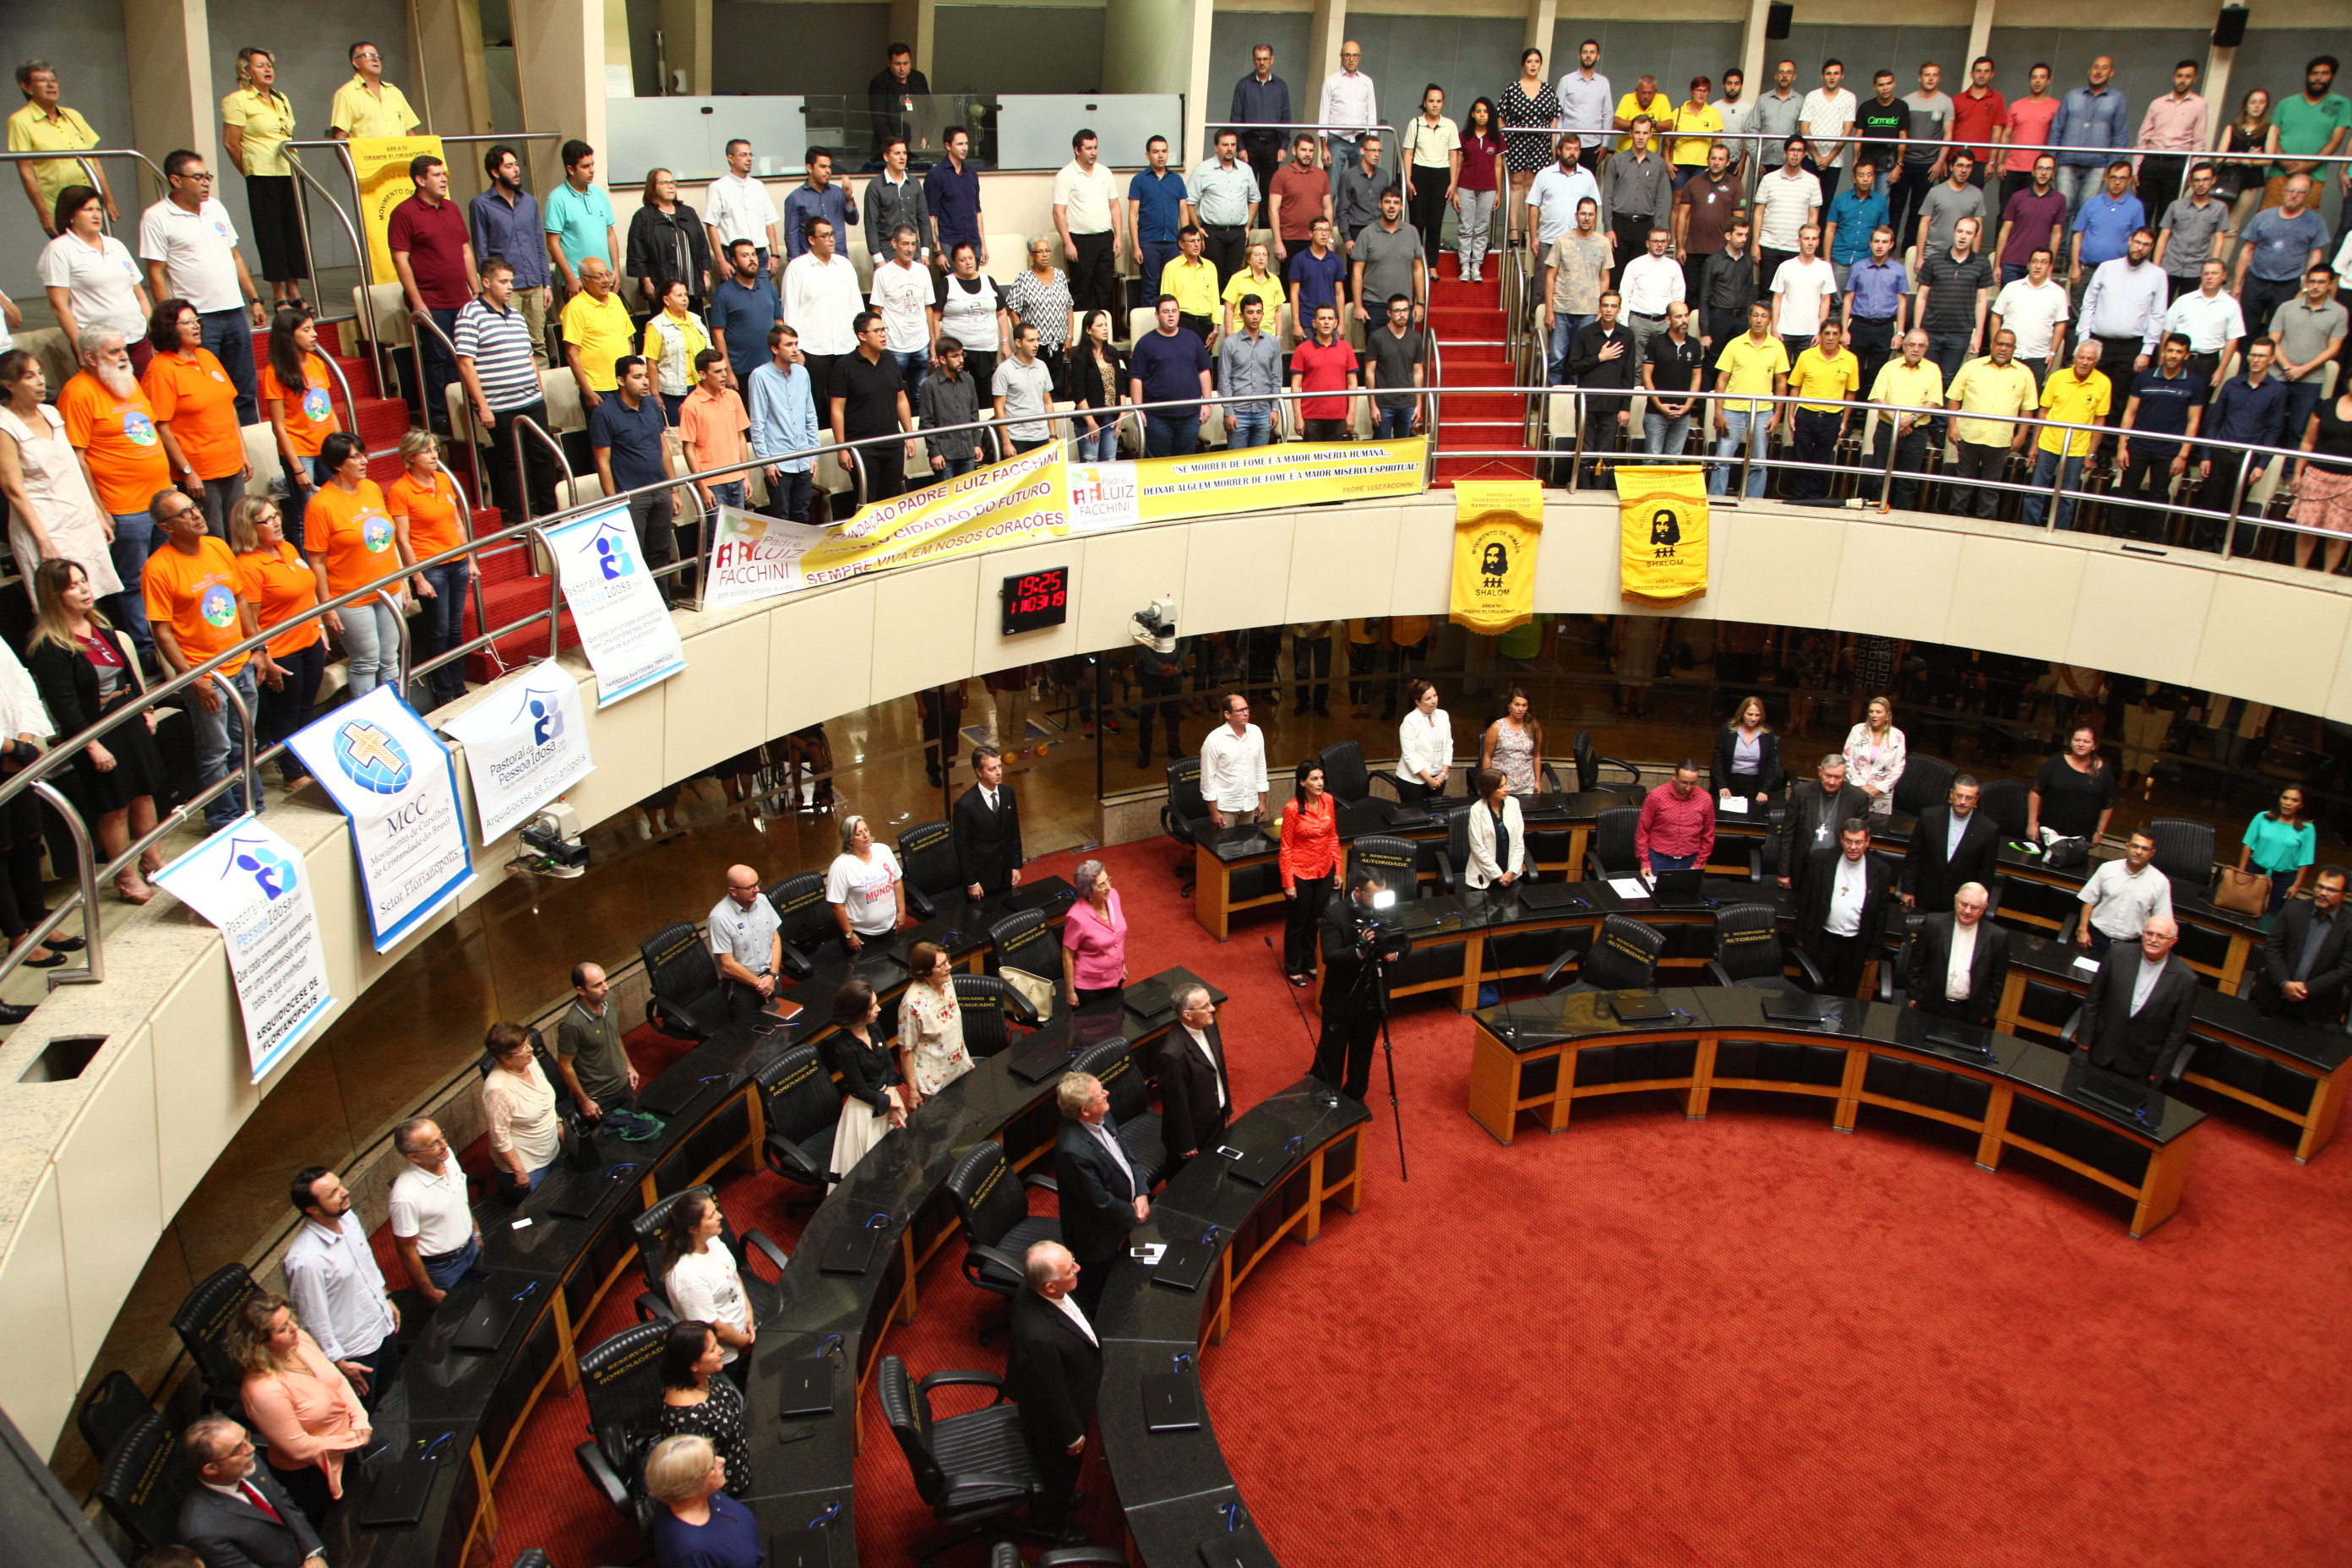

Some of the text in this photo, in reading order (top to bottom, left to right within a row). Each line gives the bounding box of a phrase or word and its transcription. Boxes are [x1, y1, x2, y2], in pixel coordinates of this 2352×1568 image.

[378, 188, 404, 220] MOVIMENTO
[1190, 462, 1227, 472] MORRER
[1230, 460, 1241, 468] DE
[1244, 457, 1266, 467] FOME
[1268, 454, 1274, 465] É
[1276, 455, 1282, 464] A
[1283, 454, 1310, 463] MAIOR
[1313, 449, 1348, 461] MISÉRIA
[1349, 449, 1391, 459] HUMANA...
[1102, 476, 1127, 486] Padre
[1143, 462, 1418, 496] DEIXAR ALGUEM MORRER DE FOME É A MAIOR MISÉRIA ESPIRITUAL!
[828, 449, 1059, 542] FUNDAÇÃO PADRE LUIZ FACCHINI
[1102, 485, 1135, 501] LUIZ
[894, 482, 1051, 538] CIDADÃO DO FUTURO
[1080, 501, 1130, 517] FACCHINI
[1639, 501, 1665, 529] MOVIMENTO
[754, 546, 807, 561] LUIZ
[763, 536, 802, 548] Padre
[1471, 530, 1498, 555] MOVIMENTO
[806, 560, 873, 585] SEMPRE
[876, 551, 908, 568] VIVA
[912, 544, 934, 558] EM
[935, 530, 983, 553] NOSOS
[1646, 559, 1684, 568] SHALOM
[564, 576, 605, 596] Pastoral da
[719, 562, 789, 586] FACCHINI
[1018, 570, 1062, 596] 19:25
[574, 591, 606, 609] Pessoa
[604, 580, 632, 598] Idosa
[489, 746, 525, 776] Pastoral
[525, 744, 534, 754] da
[498, 758, 531, 786] Pessoa
[531, 741, 557, 765] Idosa
[386, 793, 428, 838] MCC
[486, 792, 532, 829] Arquidiocese
[533, 784, 543, 795] de
[370, 805, 449, 868] Movimento de Cursilhos
[373, 815, 451, 879] de Cristandade do Brasil
[912, 834, 950, 852] HOMENAGEADO
[917, 831, 942, 843] RESERVADO
[1361, 858, 1408, 867] AUTORIDADE
[379, 891, 403, 915] Setor
[784, 894, 825, 912] HOMENAGEADO
[788, 891, 817, 905] RESERVADO
[225, 899, 259, 935] Pastoral
[259, 898, 269, 909] da
[237, 917, 268, 950] Pessoa
[267, 897, 292, 926] Idosa
[662, 937, 689, 956] RESERVADO
[1006, 929, 1046, 951] HOMENAGEADO
[1010, 927, 1038, 943] RESERVADO
[1616, 937, 1646, 955] RESERVADO
[1725, 934, 1772, 943] AUTORIDADE
[657, 938, 698, 966] HOMENAGEADO
[1607, 939, 1650, 964] AUTORIDADE
[256, 986, 308, 1042] ARQUIDIOCESE
[308, 976, 319, 990] DE
[773, 1066, 818, 1097] HOMENAGEADO
[778, 1064, 808, 1086] RESERVADO
[972, 1166, 1006, 1209] HOMENAGEADO
[975, 1165, 999, 1195] RESERVADO
[600, 1345, 665, 1385] HOMENAGEAD
[607, 1340, 657, 1371] RESERVADO
